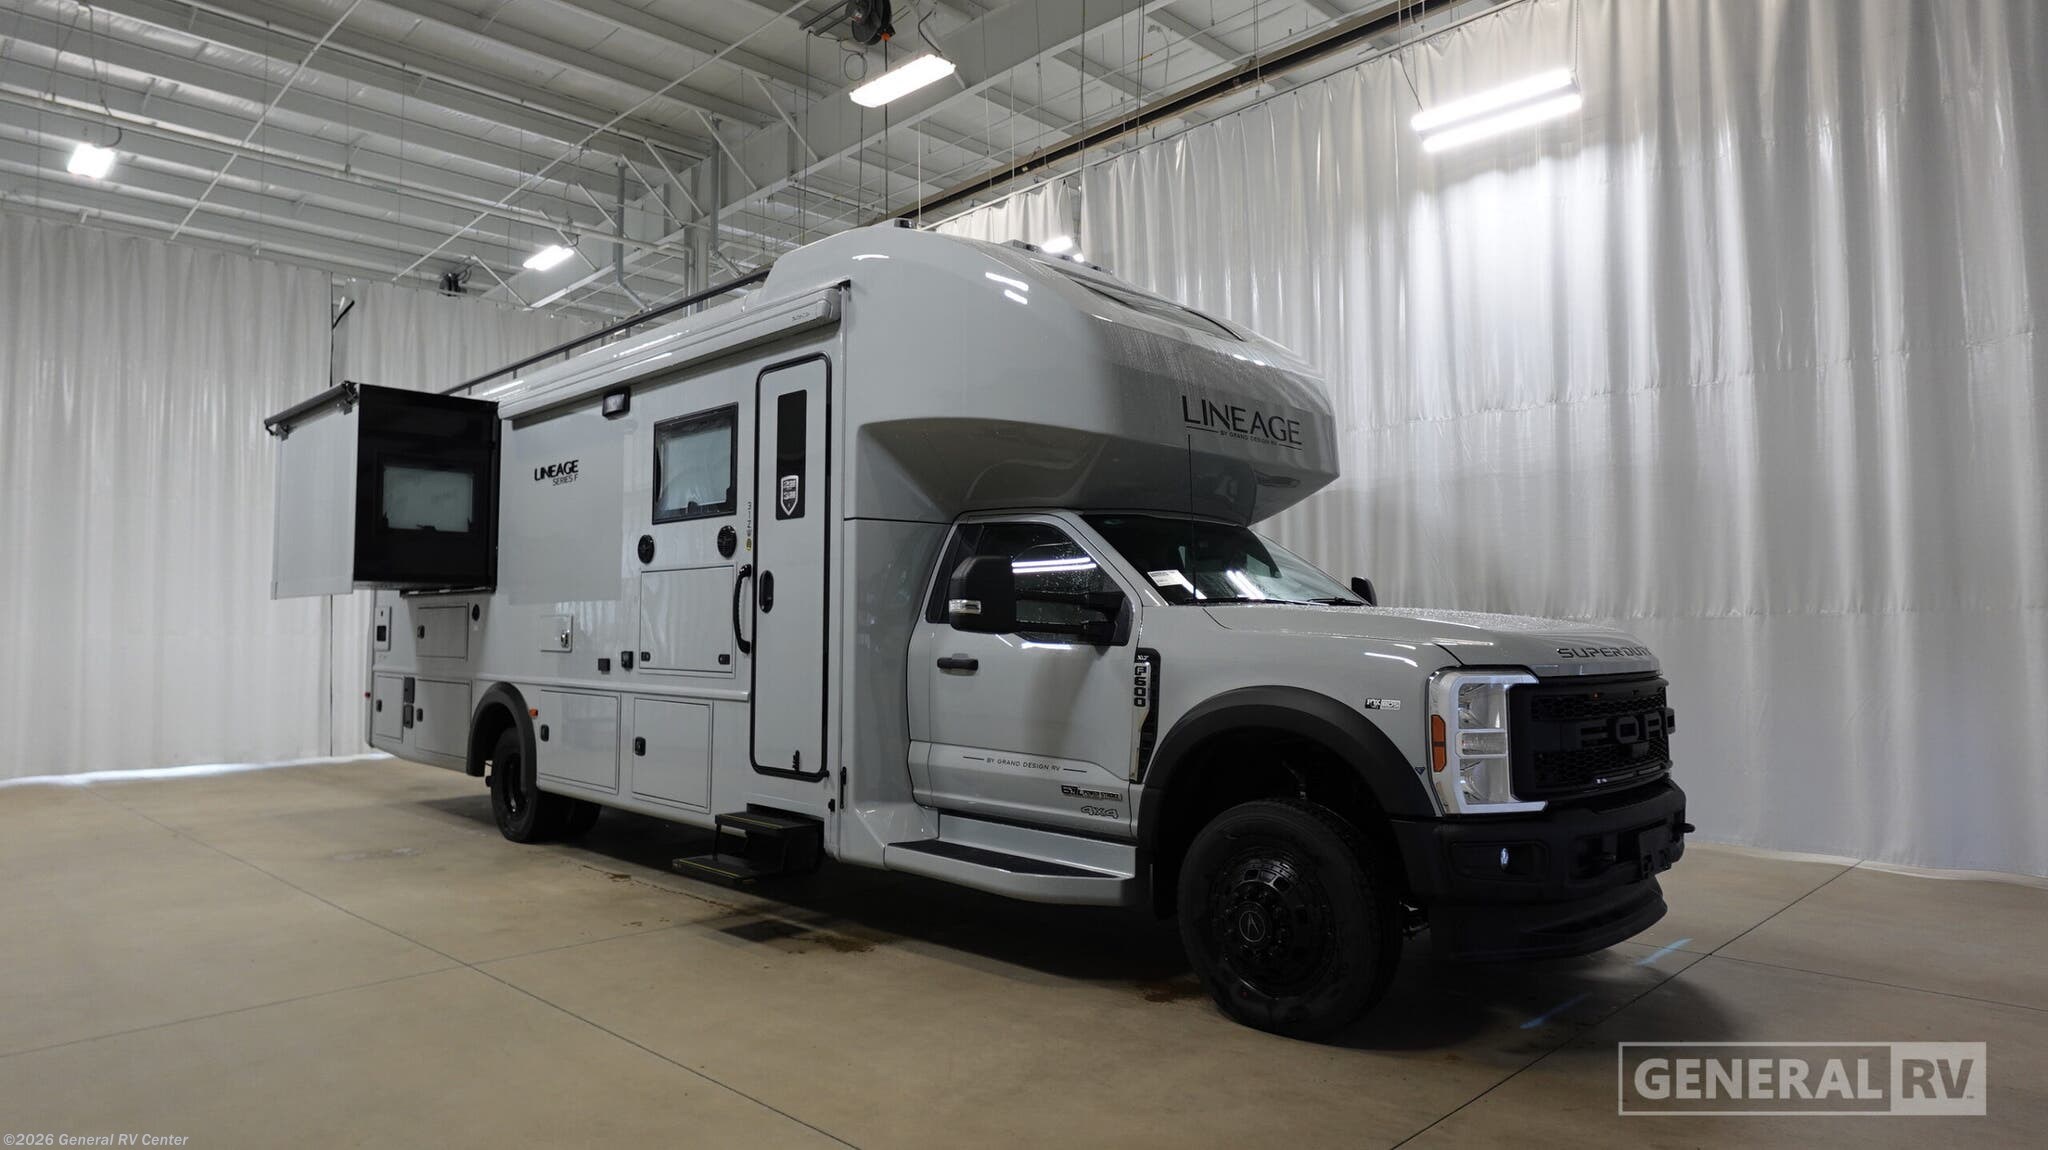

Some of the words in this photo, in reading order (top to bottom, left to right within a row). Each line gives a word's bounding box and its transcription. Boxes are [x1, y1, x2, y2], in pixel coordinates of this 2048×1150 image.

[1181, 395, 1303, 446] LINEAGE
[534, 459, 579, 481] LINEAGE
[552, 475, 573, 486] SERIES
[1134, 665, 1147, 708] F600
[997, 759, 1021, 767] GRAND
[1023, 762, 1049, 770] DESIGN
